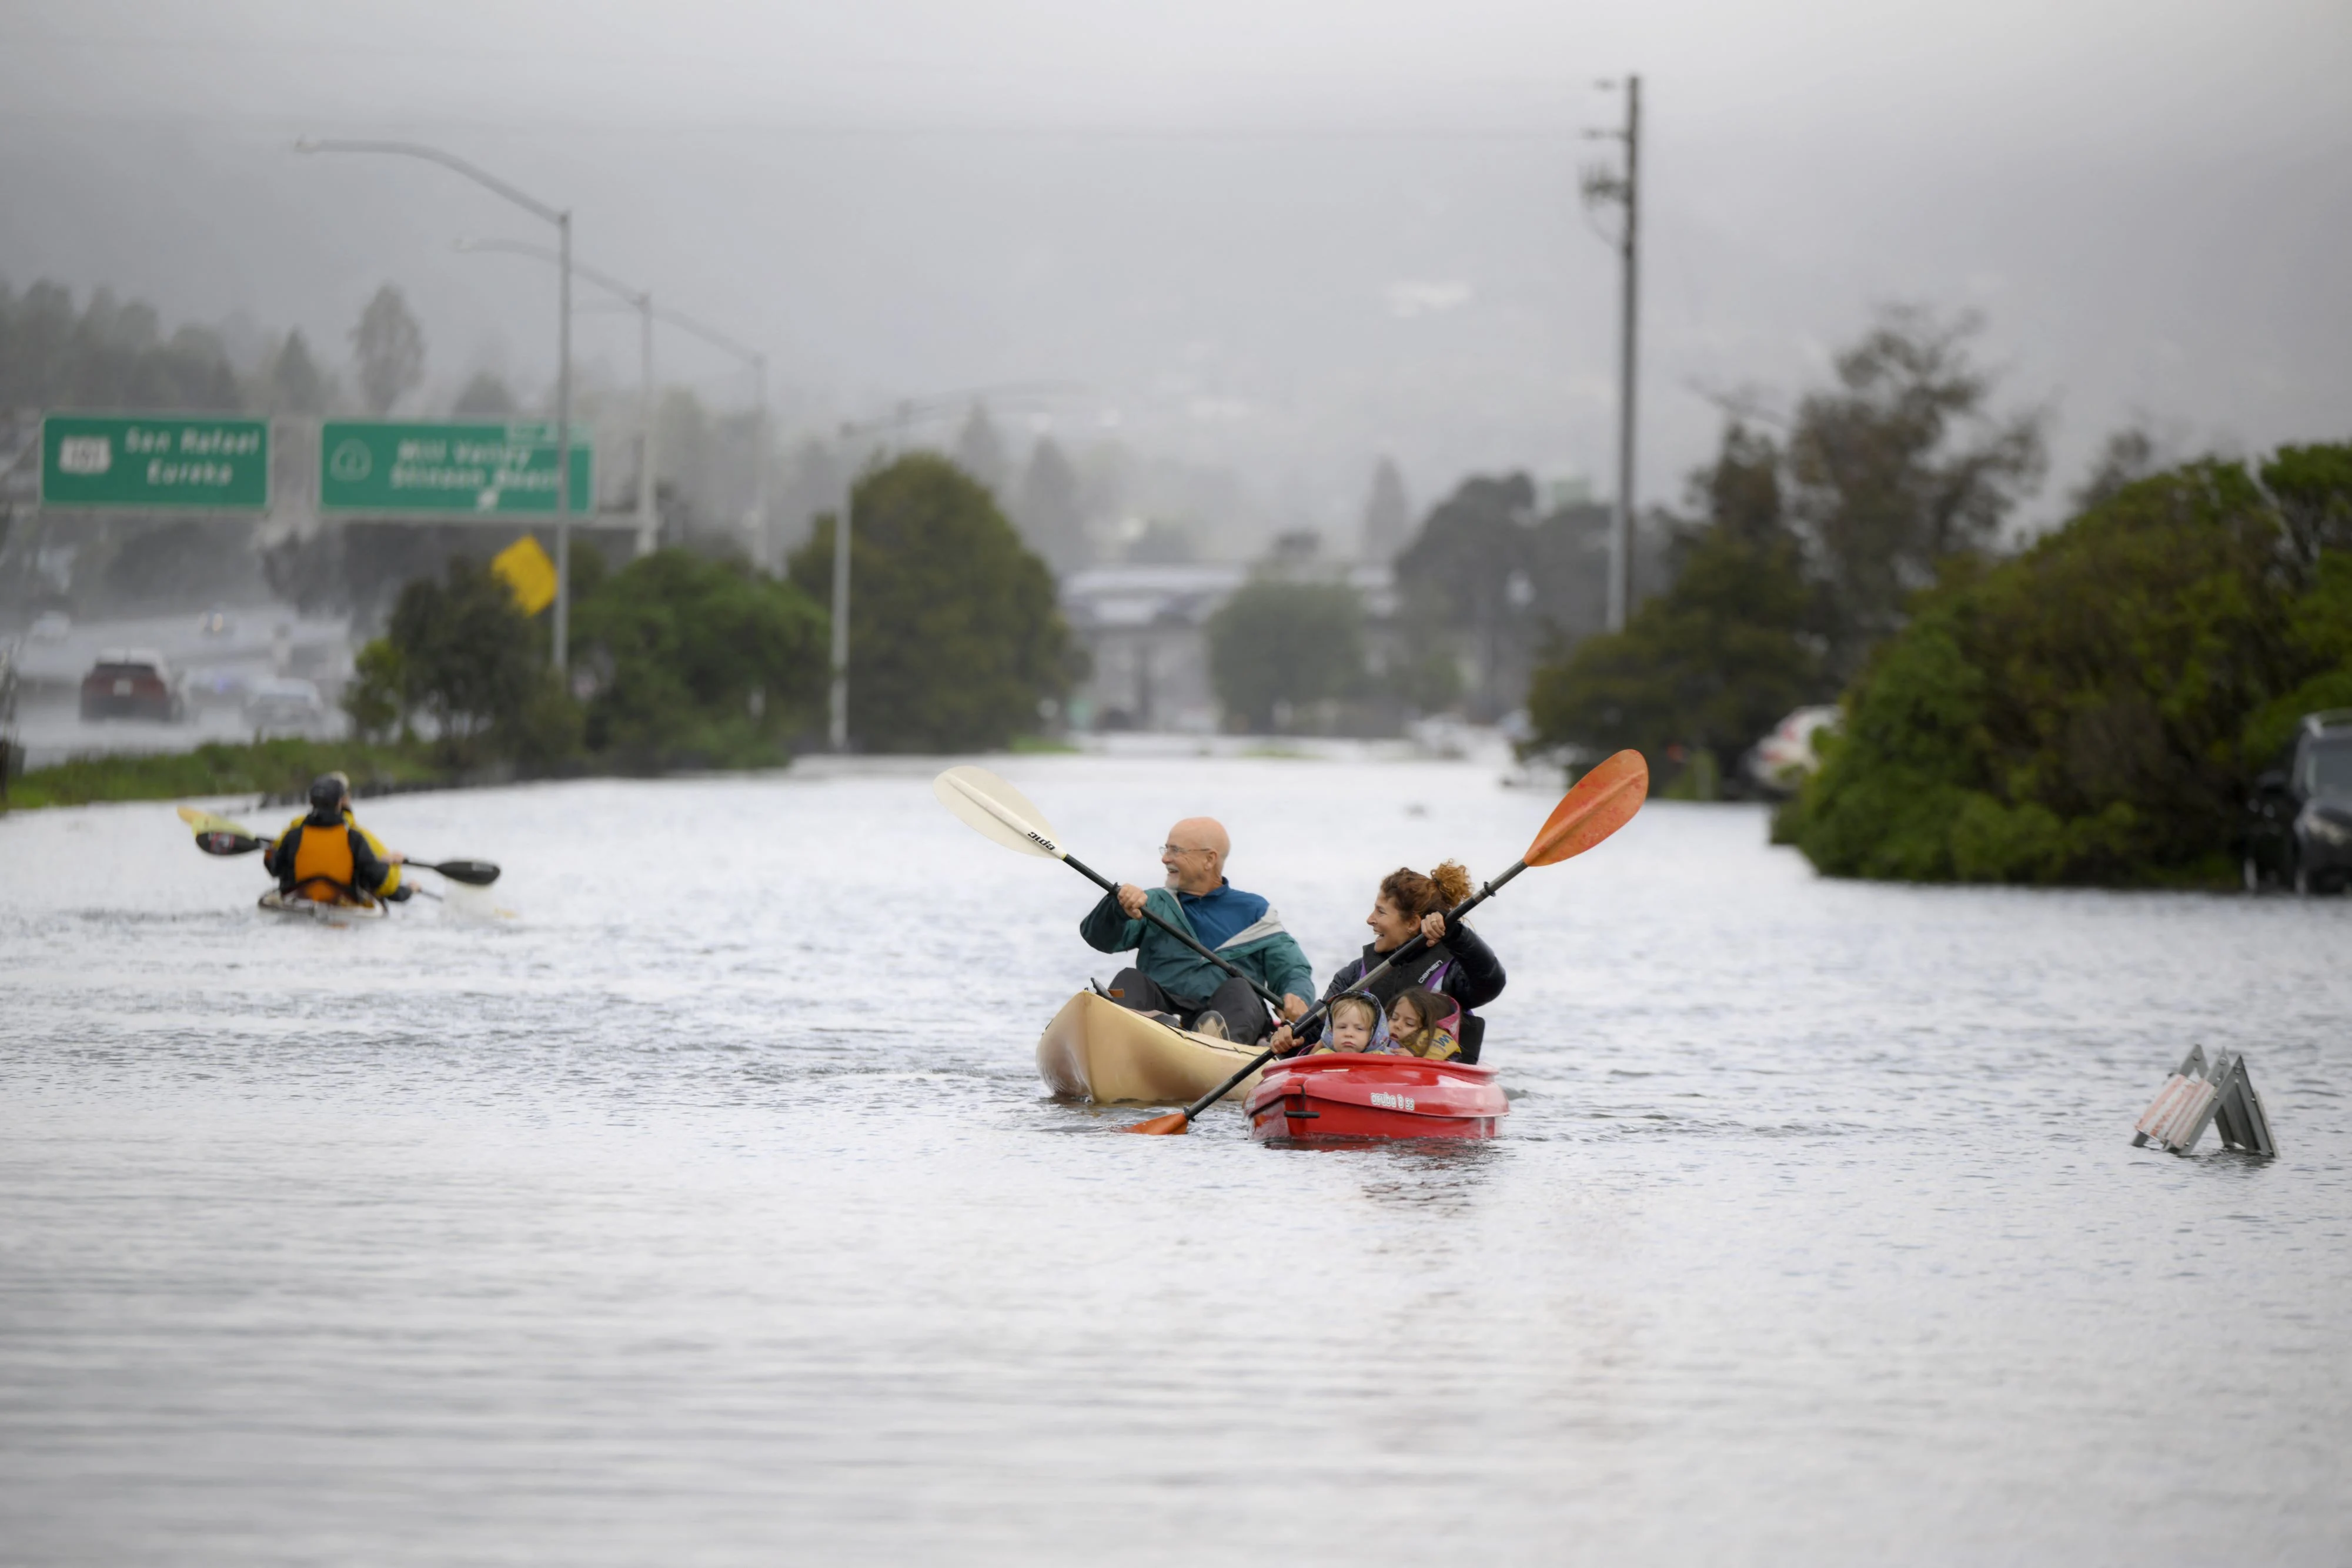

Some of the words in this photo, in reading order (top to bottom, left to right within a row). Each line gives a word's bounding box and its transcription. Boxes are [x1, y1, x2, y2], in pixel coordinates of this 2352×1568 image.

[124, 426, 171, 454] San
[179, 427, 259, 455] Rafael
[147, 459, 233, 486] Eureka
[1027, 831, 1055, 851] epic
[1371, 1092, 1396, 1108] aruba
[1397, 1094, 1404, 1109] 8
